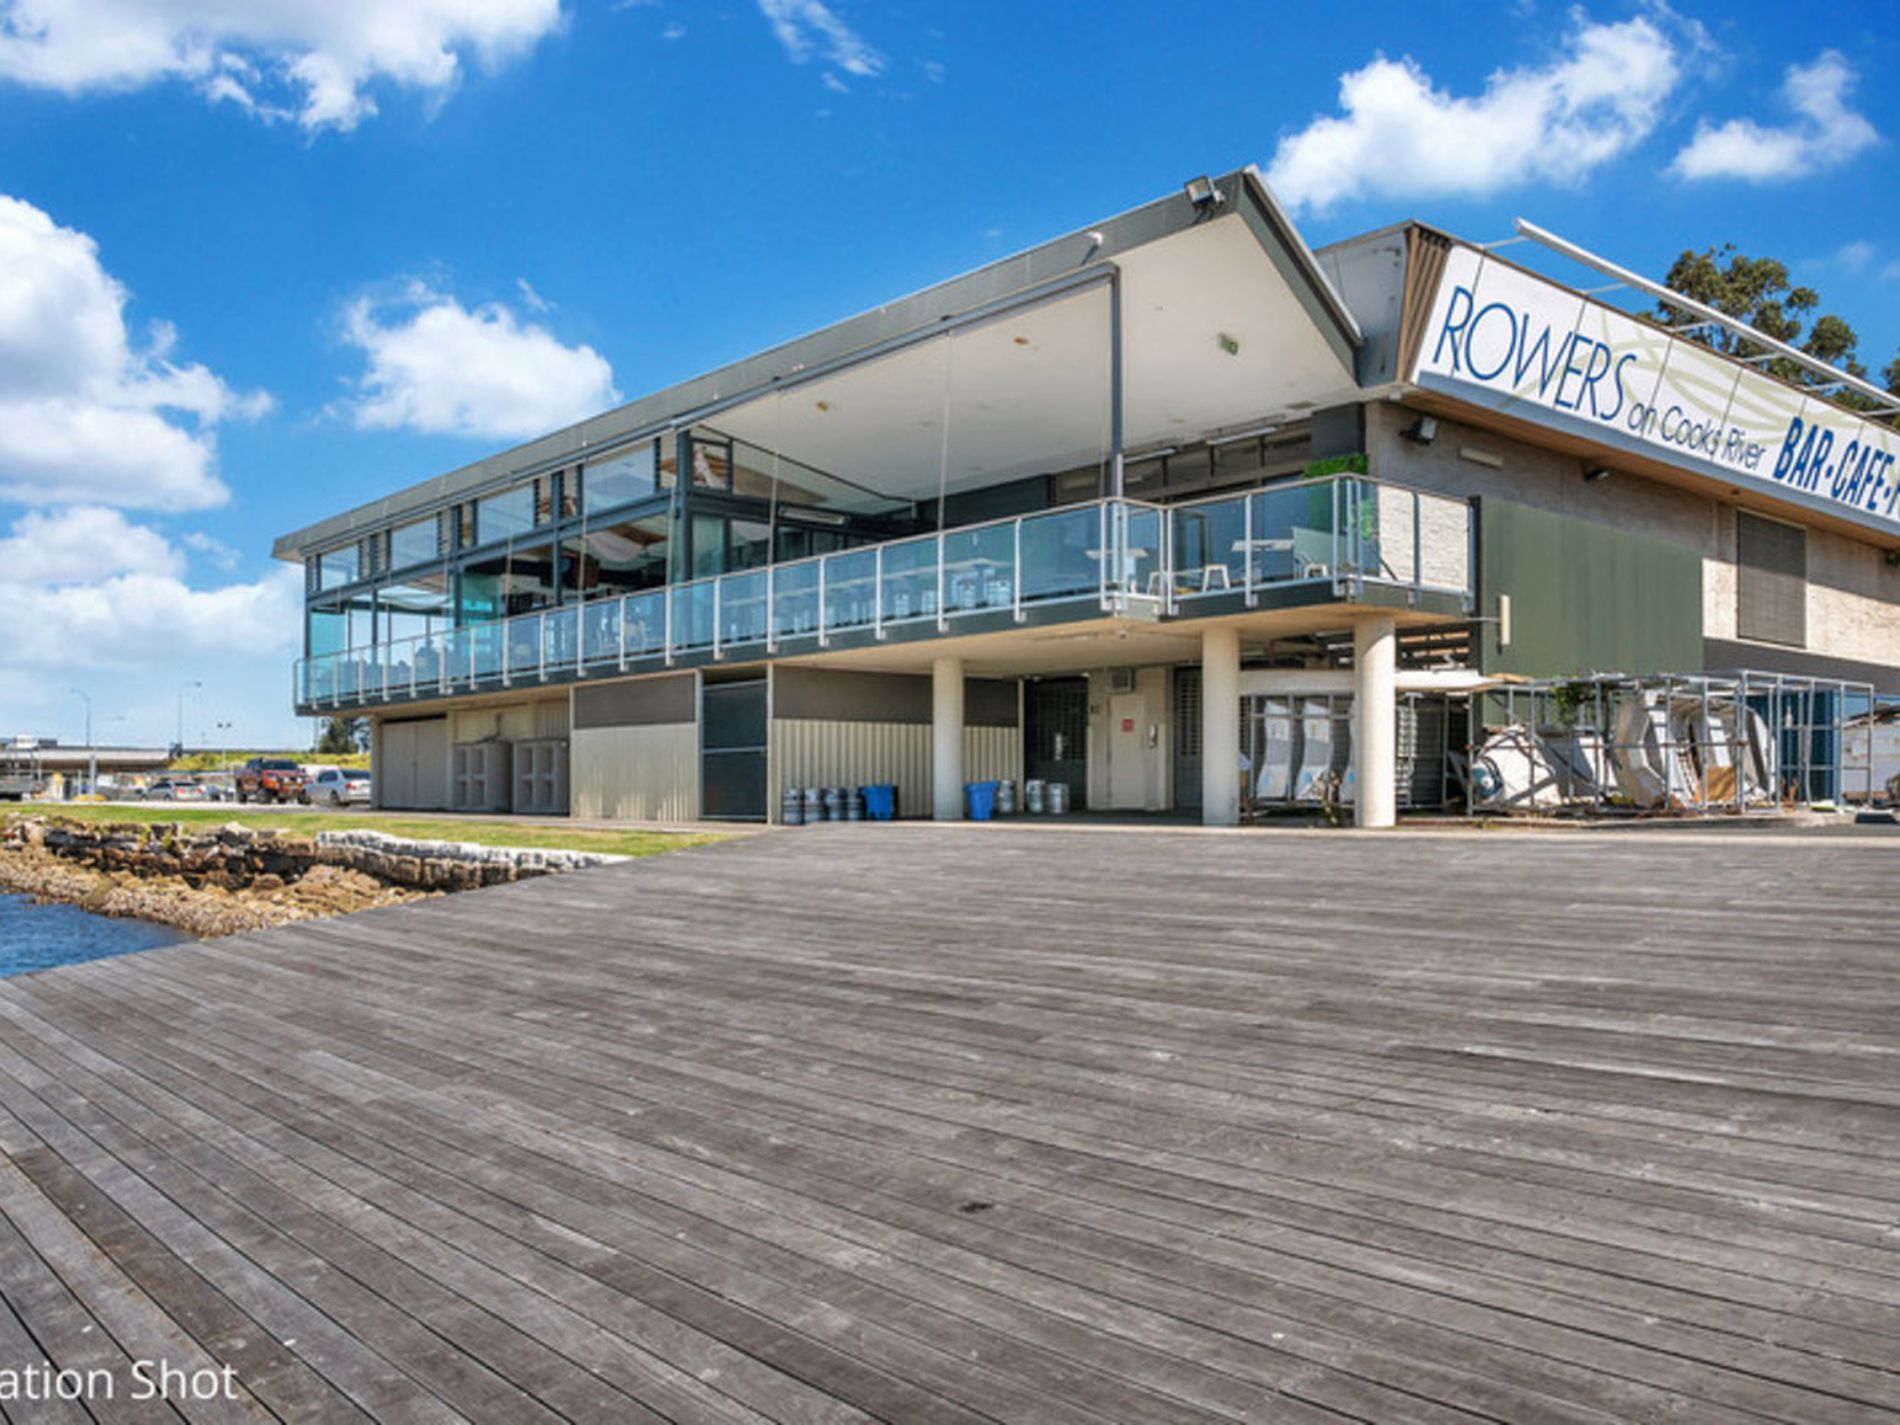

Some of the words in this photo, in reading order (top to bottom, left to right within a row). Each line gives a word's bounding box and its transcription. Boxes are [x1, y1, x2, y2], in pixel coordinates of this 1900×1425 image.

[1432, 285, 1637, 421] ROWERS
[1627, 402, 1658, 436] on
[1660, 405, 1722, 456] Cooks
[1721, 427, 1766, 470] River
